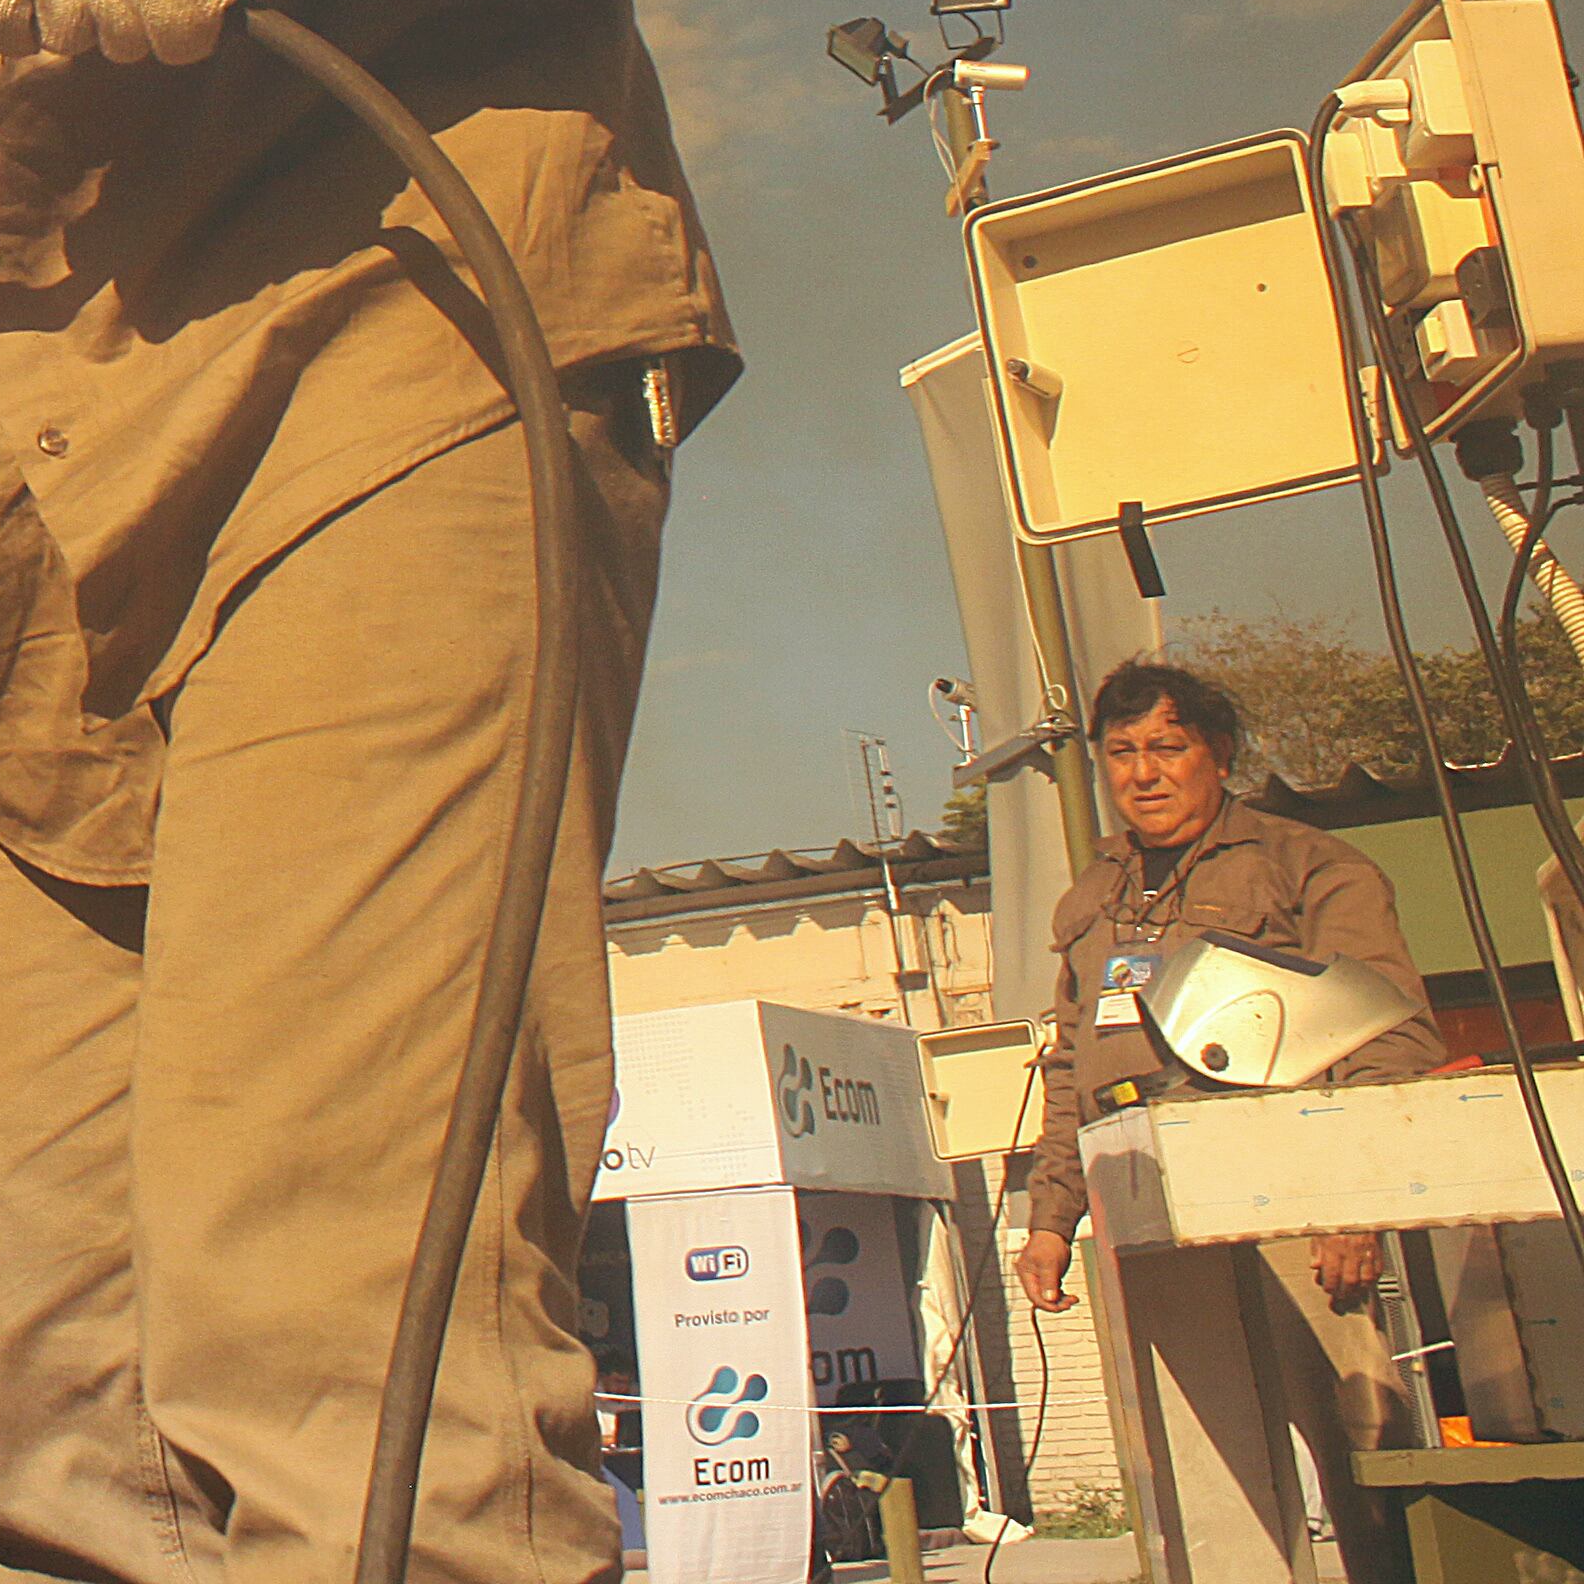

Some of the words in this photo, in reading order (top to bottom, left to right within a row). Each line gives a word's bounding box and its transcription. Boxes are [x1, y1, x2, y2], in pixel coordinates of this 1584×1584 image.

[818, 1066, 880, 1125] Ecom
[674, 1310, 738, 1327] Provisto
[743, 1309, 770, 1325] por
[693, 1457, 770, 1486] Ecom
